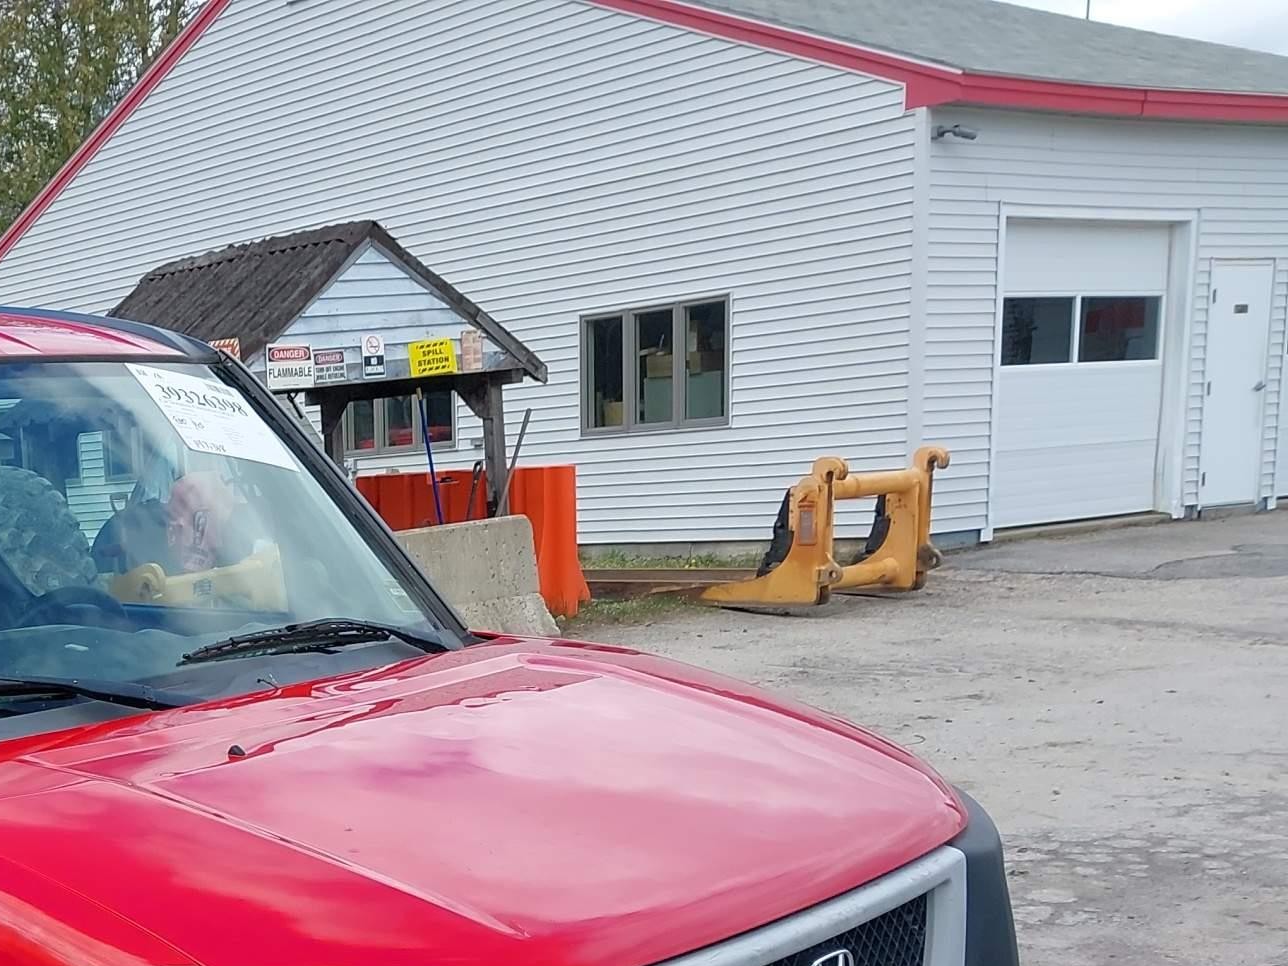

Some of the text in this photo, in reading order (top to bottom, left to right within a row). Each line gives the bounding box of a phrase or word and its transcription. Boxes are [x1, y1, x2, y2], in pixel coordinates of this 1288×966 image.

[273, 349, 305, 359] DANGER
[422, 348, 444, 357] SPILL
[317, 353, 341, 363] DANGER
[417, 356, 450, 367] STATION
[268, 366, 312, 378] FLAMMABLE
[155, 384, 248, 416] 39326398
